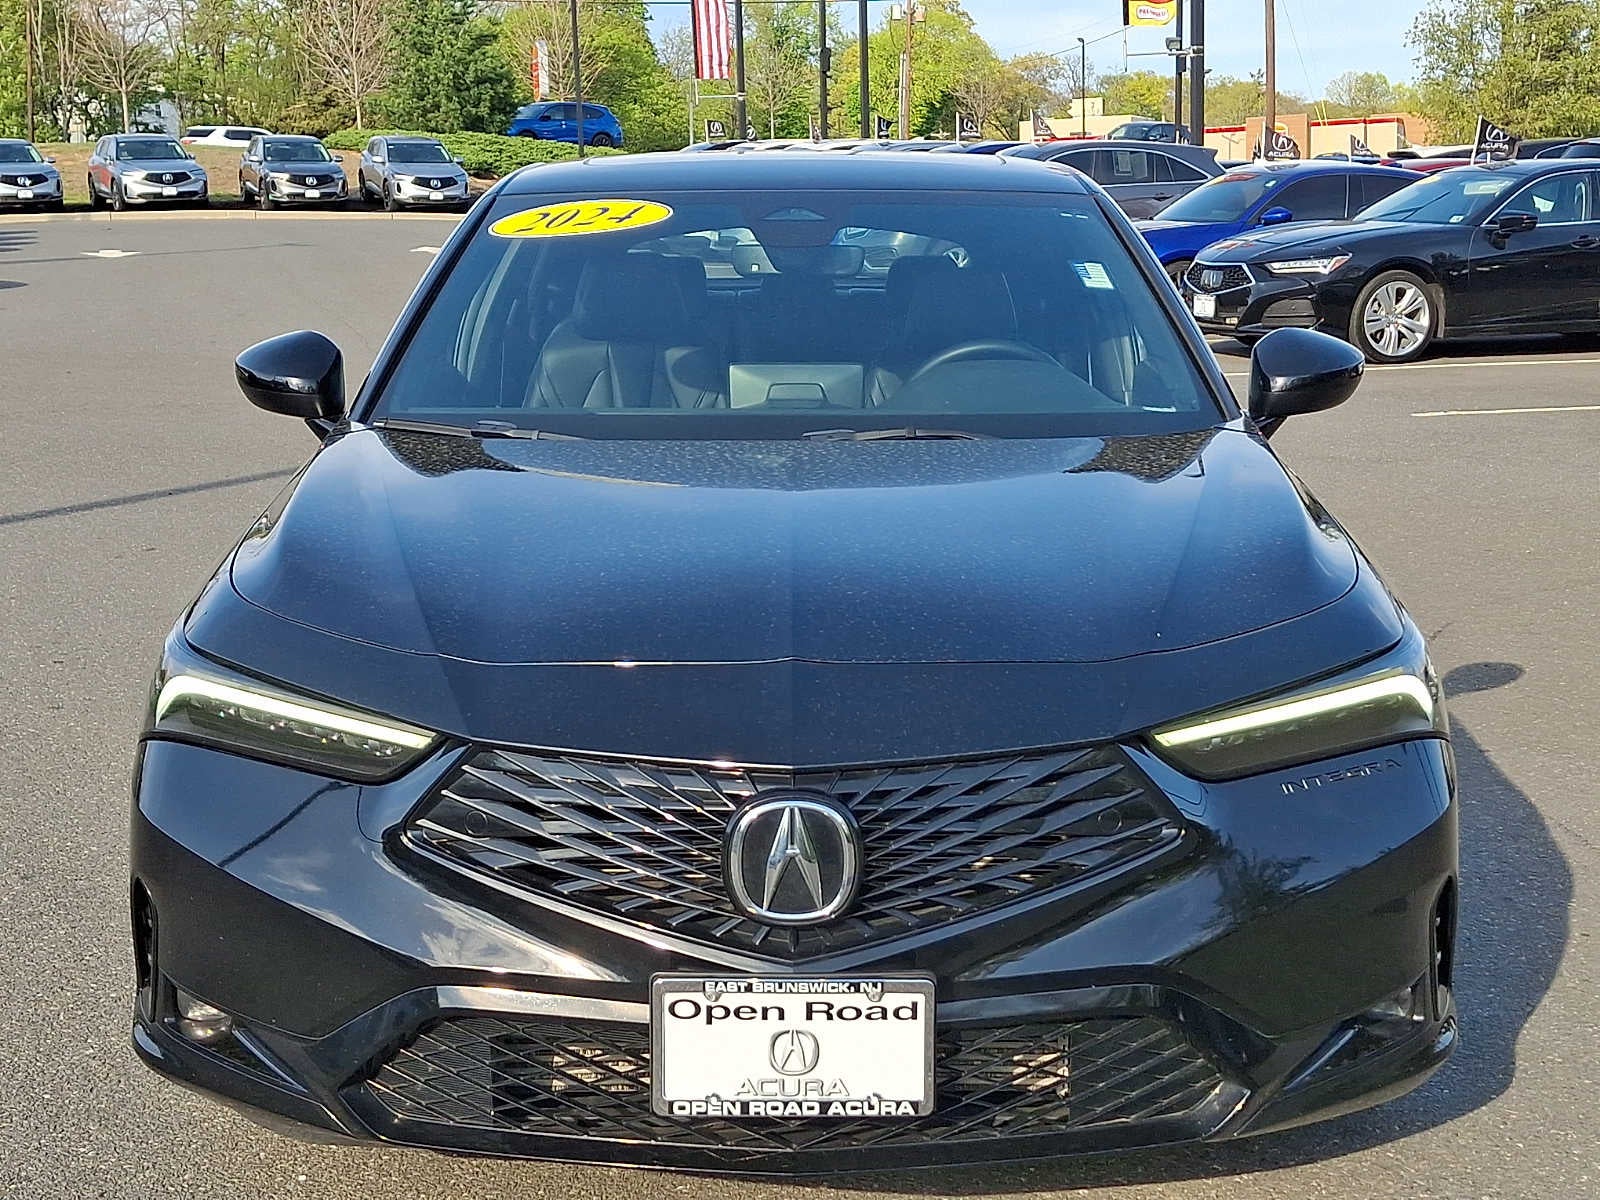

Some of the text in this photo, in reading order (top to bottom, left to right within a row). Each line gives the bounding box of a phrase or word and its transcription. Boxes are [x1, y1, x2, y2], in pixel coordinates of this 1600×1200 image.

[1266, 150, 1295, 158] ACURA
[1480, 142, 1510, 151] ACURA
[513, 205, 646, 233] 2024
[1280, 758, 1402, 795] INTEGRA
[705, 981, 748, 993] EAST
[859, 982, 882, 994] NJ
[668, 999, 918, 1025] Open Road
[736, 1078, 849, 1097] ACURA
[672, 1101, 916, 1116] OPEN ROAD ACURA
